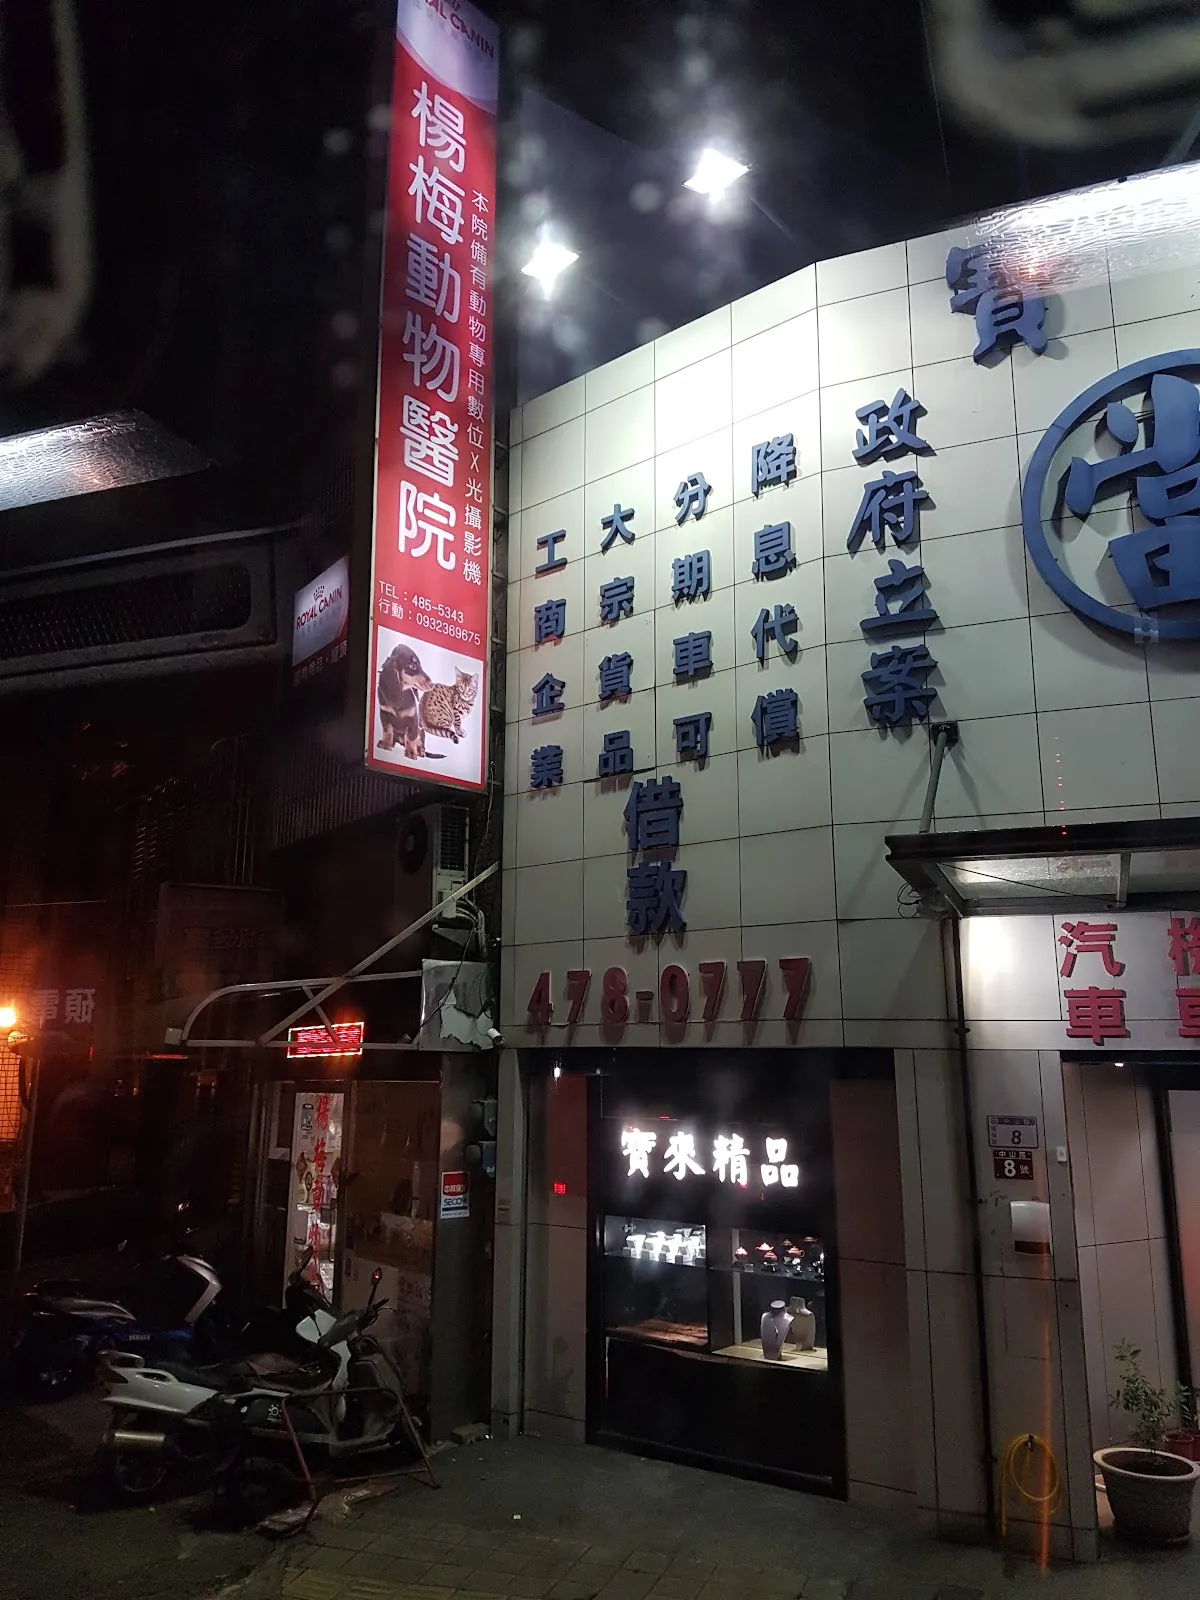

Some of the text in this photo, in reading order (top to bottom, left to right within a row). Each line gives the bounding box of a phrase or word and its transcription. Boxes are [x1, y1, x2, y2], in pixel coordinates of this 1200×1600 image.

[450, 13, 495, 58] CANIN
[397, 80, 467, 571] 楊梅動物醫院
[297, 604, 318, 630] ROYAL
[319, 585, 343, 614] CANIN
[671, 472, 712, 758] 分期車可
[751, 433, 800, 750] 降息代償
[846, 387, 938, 723] 政府立案
[530, 529, 566, 788] 工商企業
[598, 503, 636, 779] 大宗貨品
[622, 775, 687, 945] 借款
[527, 957, 811, 1028] 478-0777
[1058, 921, 1131, 1047] 汽車
[621, 1128, 799, 1187] 寶來精品
[998, 1150, 1026, 1159] 中山路
[1011, 1130, 1022, 1145] 8
